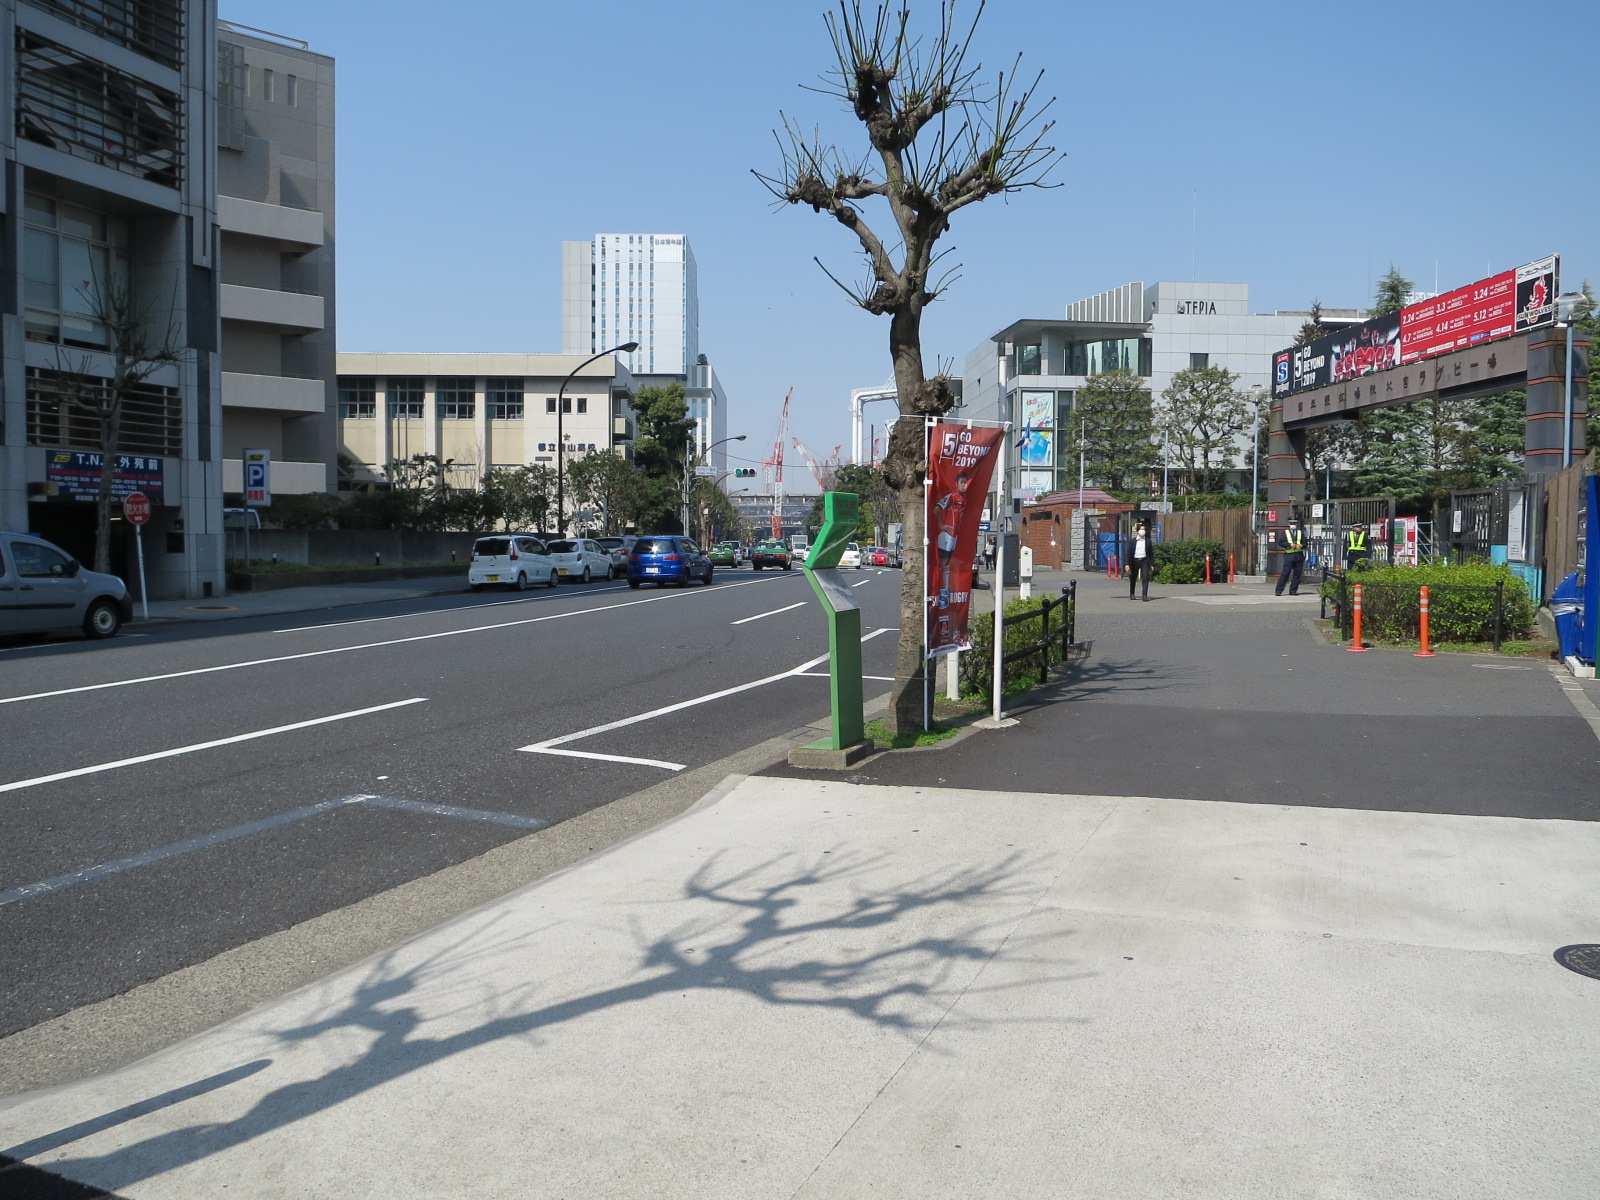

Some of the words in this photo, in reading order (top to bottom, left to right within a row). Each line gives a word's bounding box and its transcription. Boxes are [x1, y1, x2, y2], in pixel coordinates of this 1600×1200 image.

[1473, 287, 1488, 301] 3.24
[1185, 301, 1217, 315] TEPIA
[1436, 302, 1446, 313] 3.3
[1402, 312, 1415, 324] 2.24
[1473, 309, 1487, 322] 5.12
[1435, 321, 1449, 333] 4.14
[1402, 333, 1413, 343] 4.7
[1303, 345, 1311, 358] GO
[1295, 352, 1302, 378] 5
[1303, 355, 1325, 372] BEYOND
[1303, 371, 1316, 386] 2019
[960, 431, 972, 443] GO
[943, 433, 957, 456] 5
[955, 456, 977, 468] 2019
[249, 466, 264, 485] P
[950, 592, 969, 603] RUGBY
